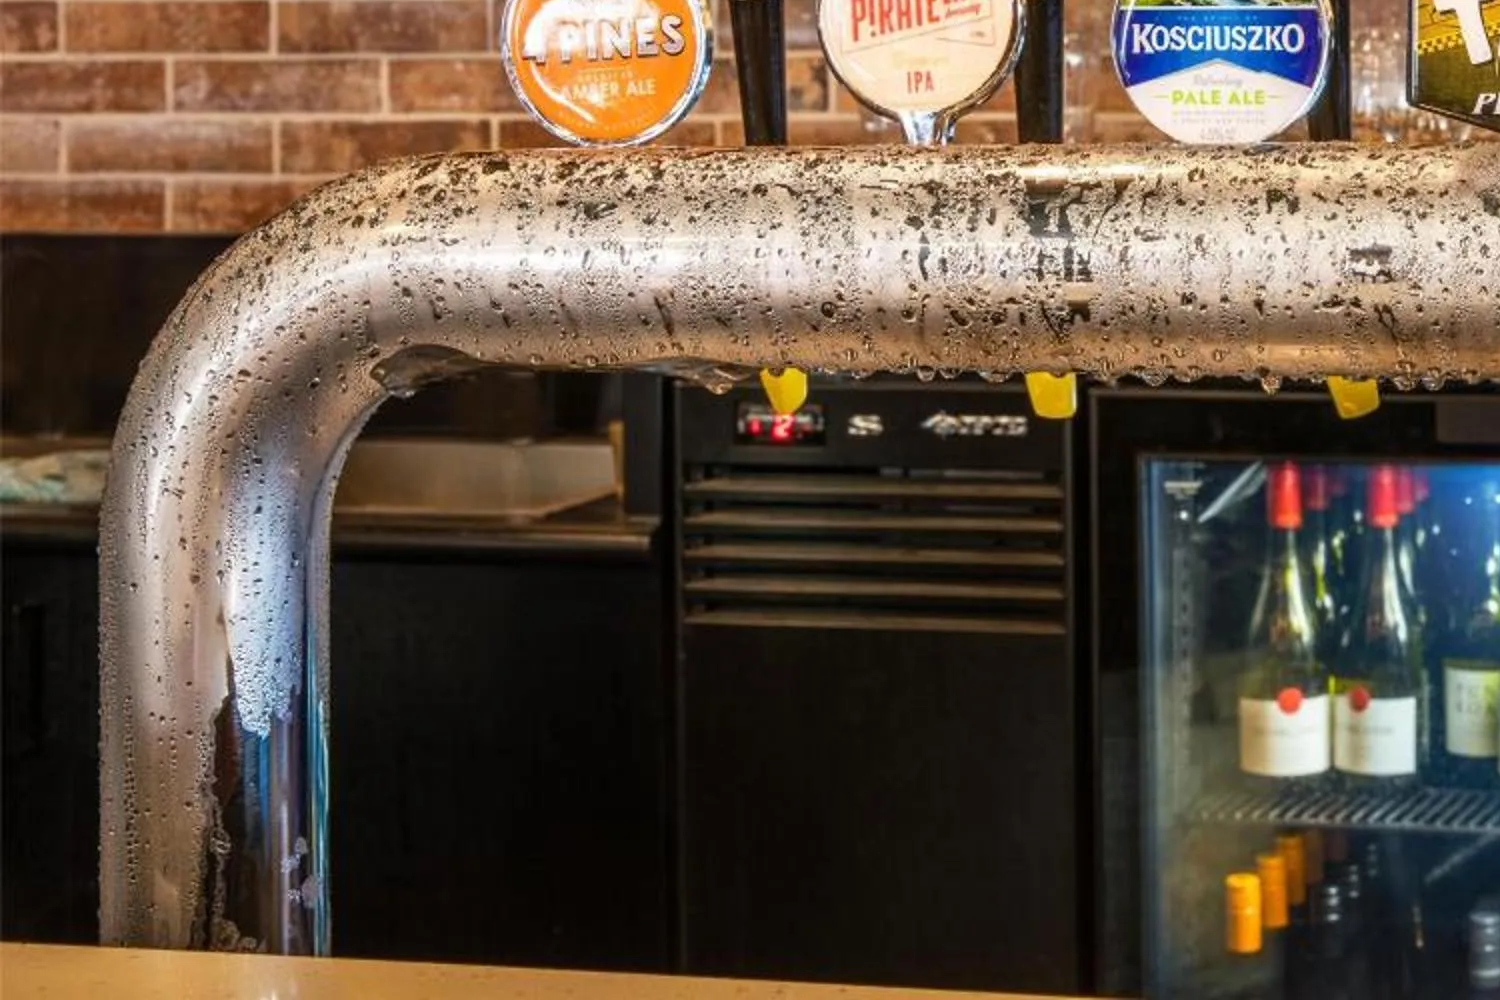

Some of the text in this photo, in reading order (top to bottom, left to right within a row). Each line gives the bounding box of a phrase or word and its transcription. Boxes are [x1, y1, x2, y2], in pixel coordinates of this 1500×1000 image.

[557, 14, 686, 63] PINES
[1131, 22, 1306, 55] KOSCIUSZKO
[626, 78, 657, 97] ALE
[907, 71, 935, 94] IPA
[1172, 89, 1266, 105] PALE ALE
